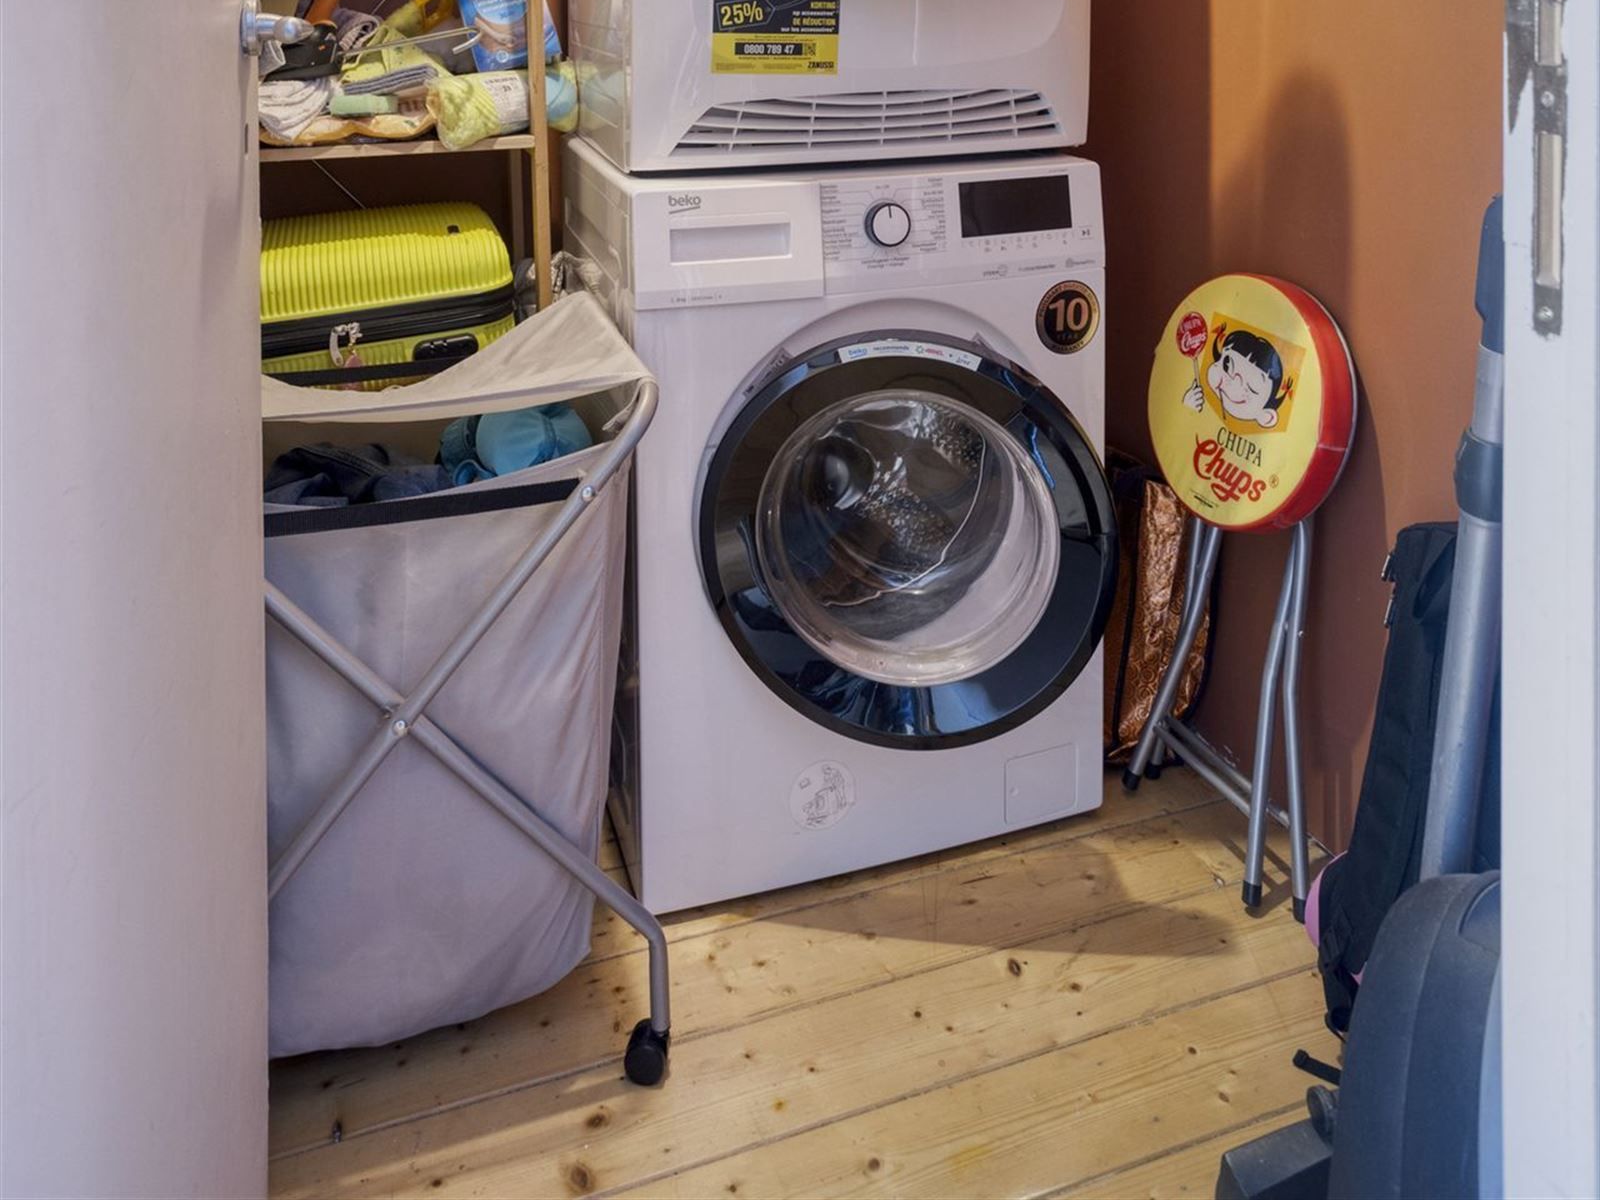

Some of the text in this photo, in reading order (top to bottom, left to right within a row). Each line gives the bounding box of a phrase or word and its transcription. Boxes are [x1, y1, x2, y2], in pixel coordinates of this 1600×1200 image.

[720, 0, 764, 27] 25%
[744, 44, 764, 54] 0800
[784, 44, 795, 54] 47
[668, 194, 701, 207] beko
[1049, 298, 1088, 332] 10
[1181, 332, 1206, 352] Chups
[1216, 426, 1262, 467] CHUPA
[1193, 432, 1267, 503] Chups
